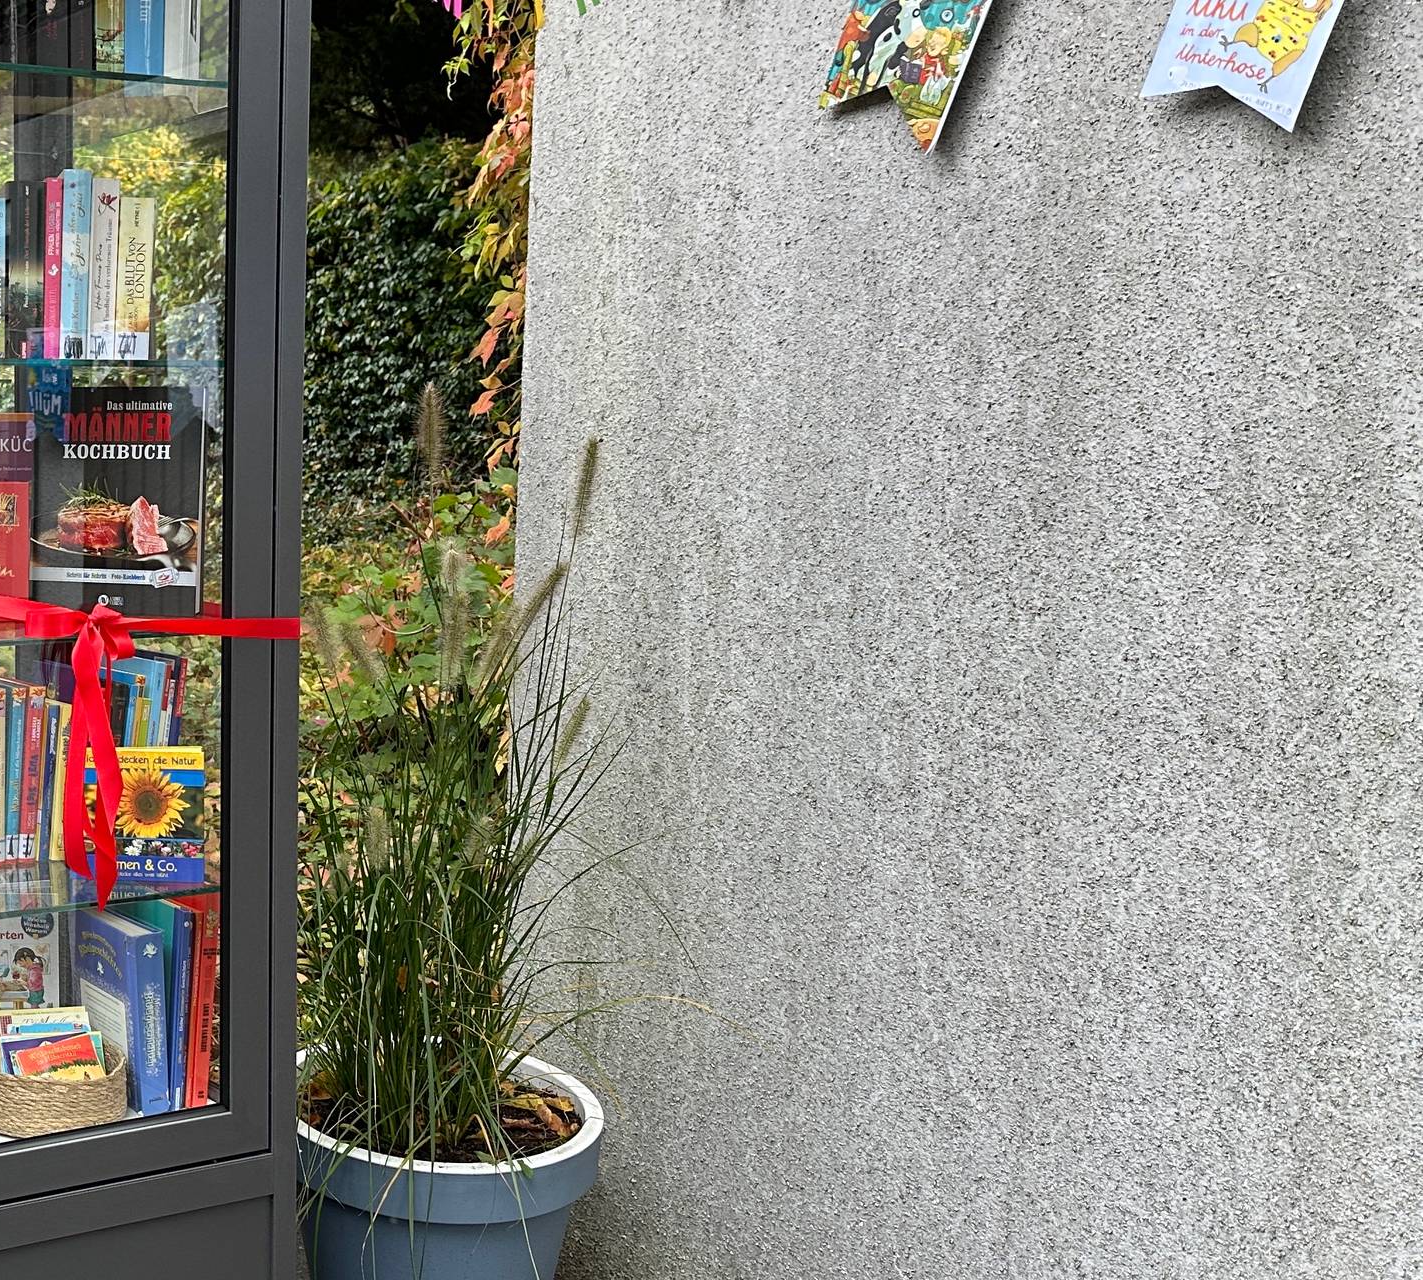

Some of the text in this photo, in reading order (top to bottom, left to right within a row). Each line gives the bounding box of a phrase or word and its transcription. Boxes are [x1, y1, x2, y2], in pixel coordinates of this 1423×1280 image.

[1180, 23, 1224, 38] in der
[1176, 44, 1266, 80] Unterhose
[124, 237, 136, 305] DAS BLUT VON
[135, 242, 147, 300] LONDON
[106, 400, 173, 410] Das ultimative
[63, 406, 172, 442] MÄNNER
[63, 444, 171, 460] KOCHBUCH
[118, 756, 149, 765] decken
[171, 757, 197, 765] Natur
[116, 859, 177, 873] men & Co.
